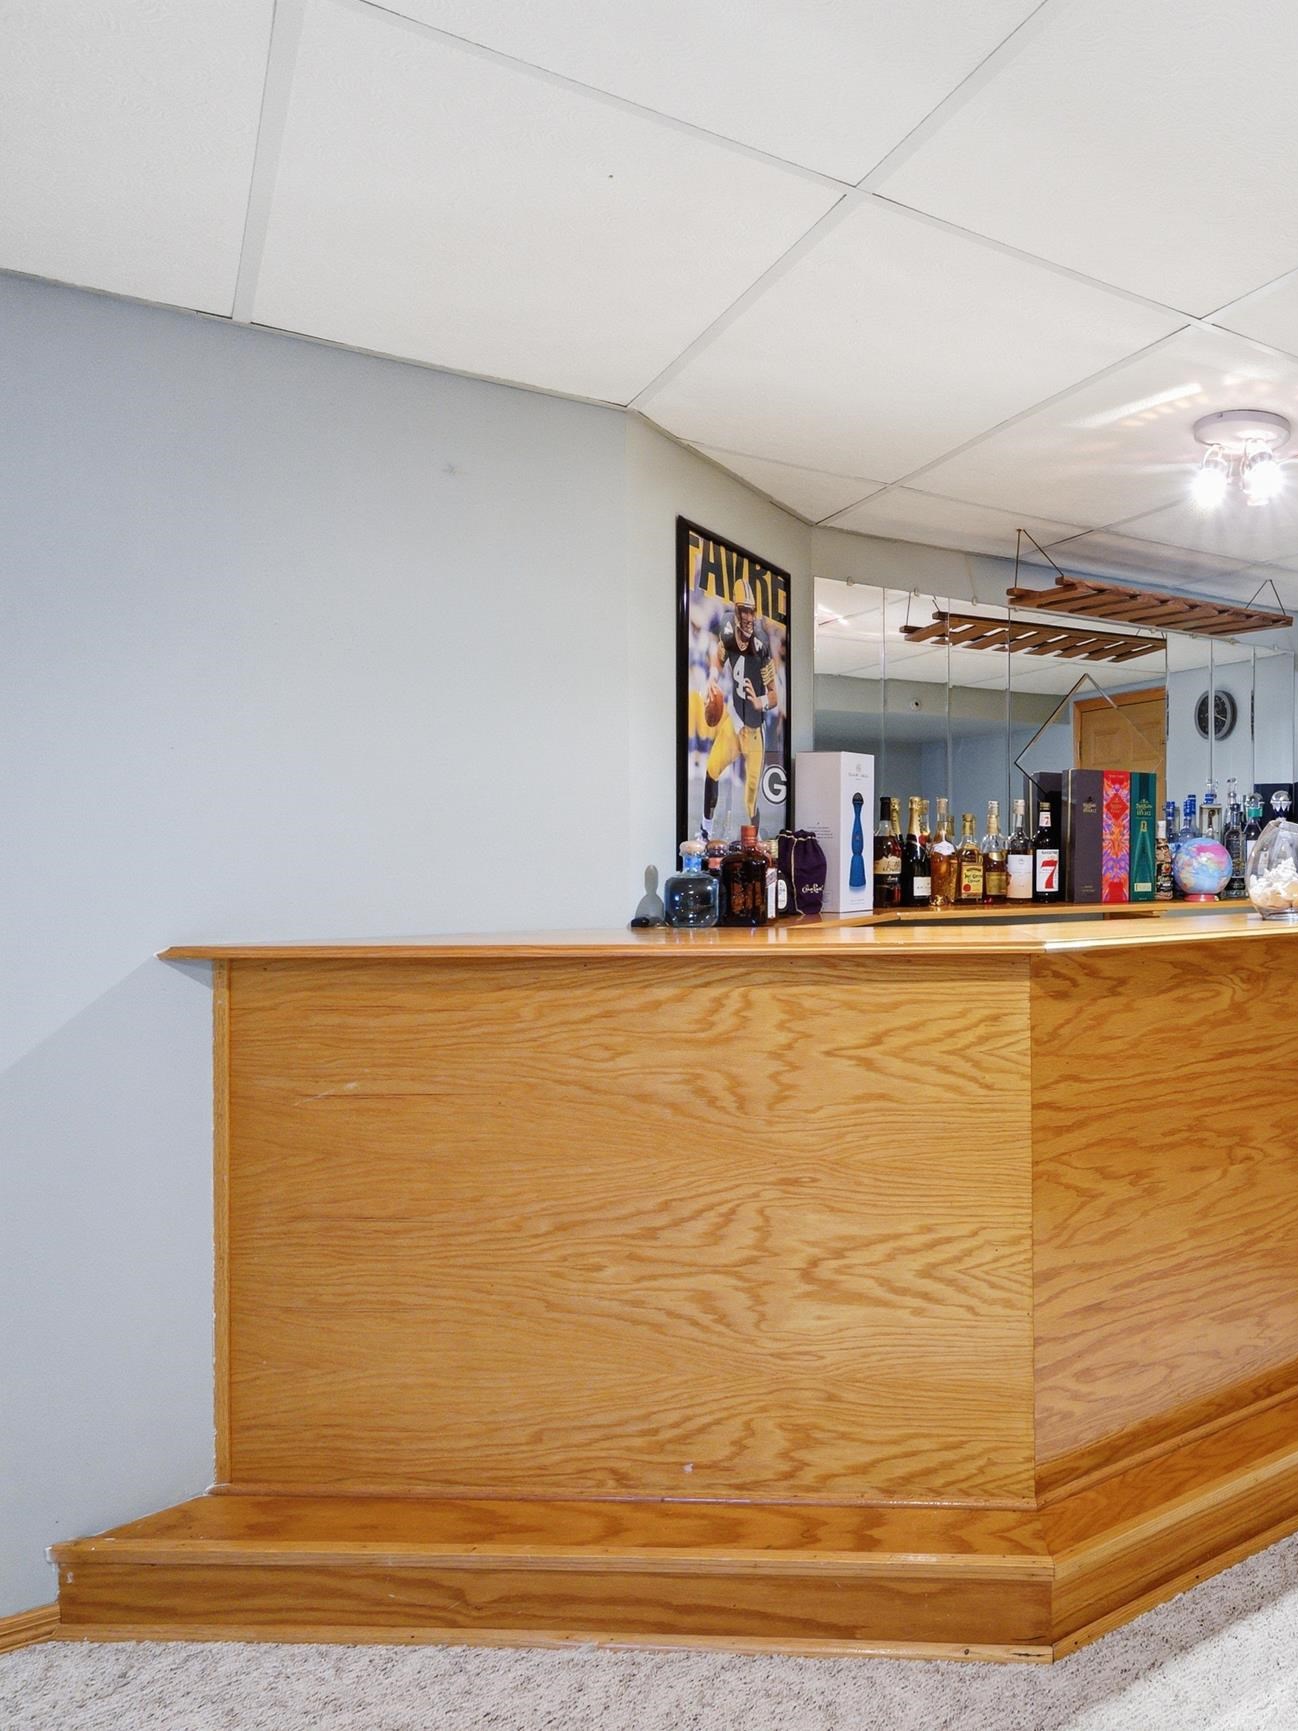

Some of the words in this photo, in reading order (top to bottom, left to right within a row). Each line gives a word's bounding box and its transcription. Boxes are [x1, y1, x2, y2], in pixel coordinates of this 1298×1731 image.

[689, 532, 786, 626] FAVRE
[763, 767, 787, 802] G
[1041, 859, 1058, 889] 7
